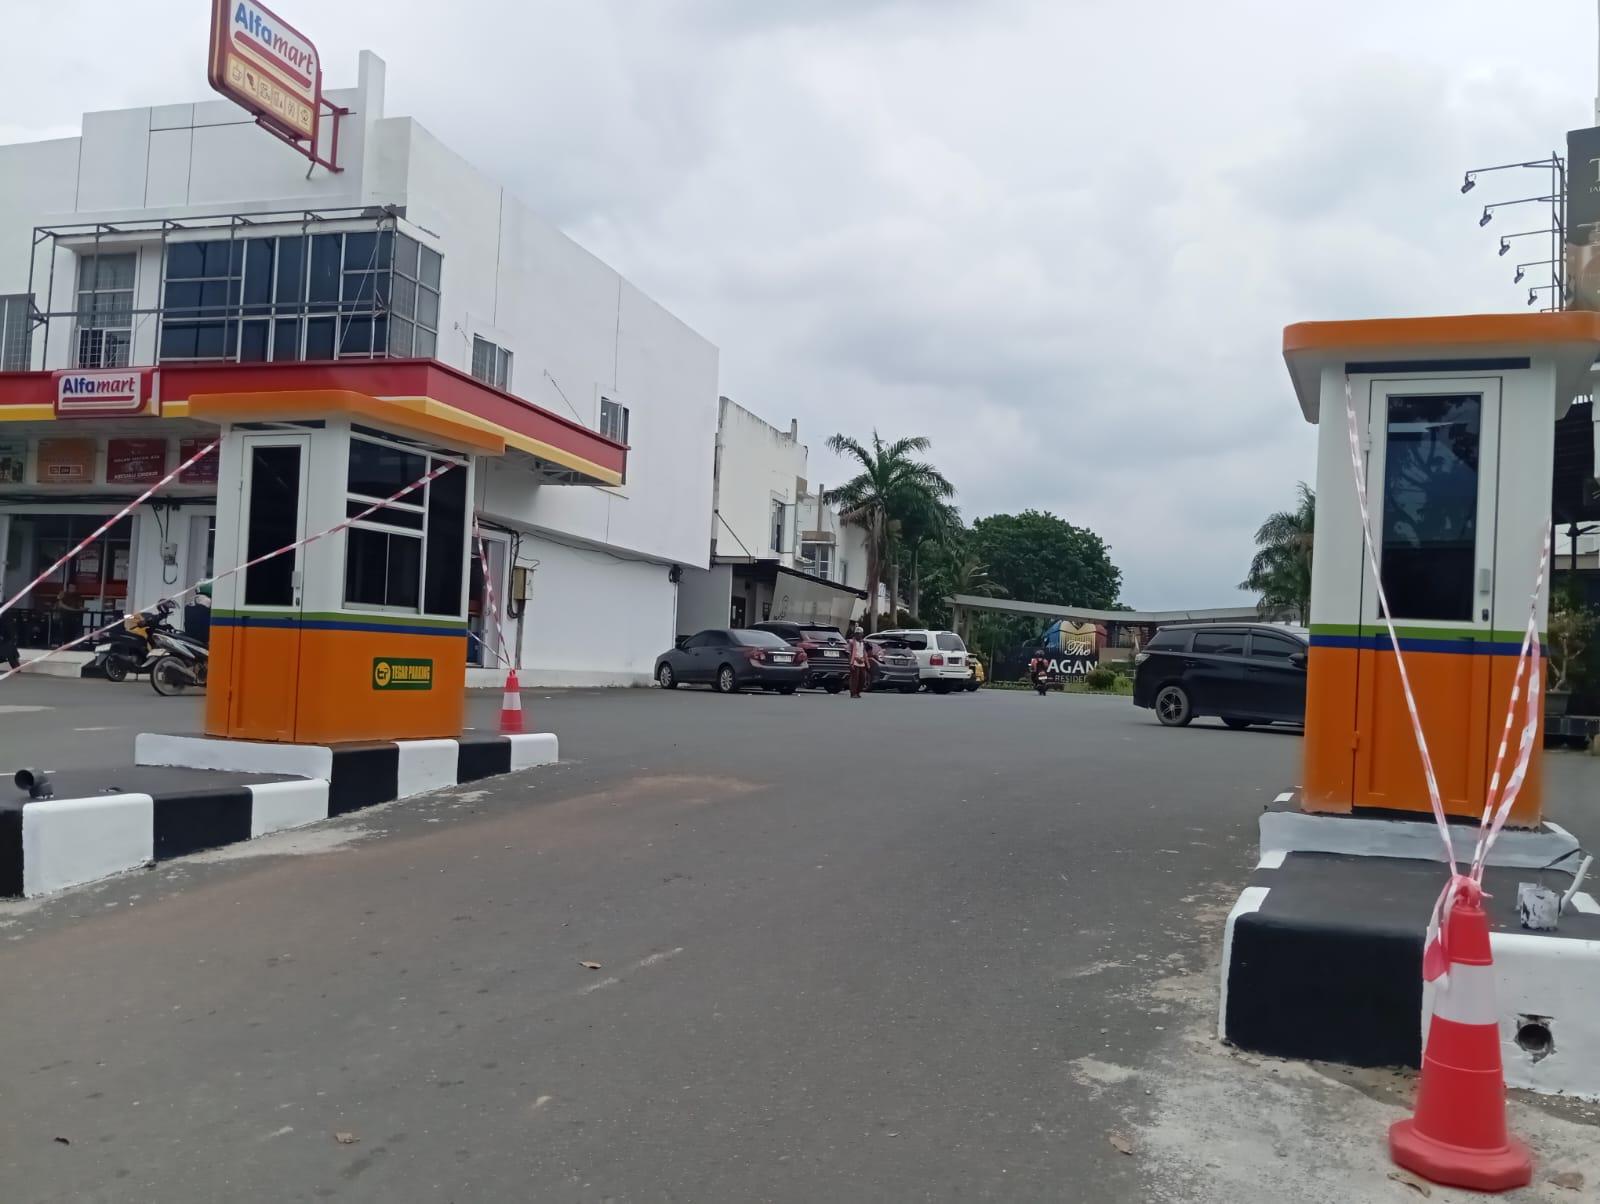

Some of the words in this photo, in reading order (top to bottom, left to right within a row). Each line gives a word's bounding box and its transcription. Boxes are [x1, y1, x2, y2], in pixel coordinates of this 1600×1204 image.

[234, 2, 314, 75] Alfamart
[62, 377, 136, 394] Alfamart
[1064, 640, 1091, 656] The
